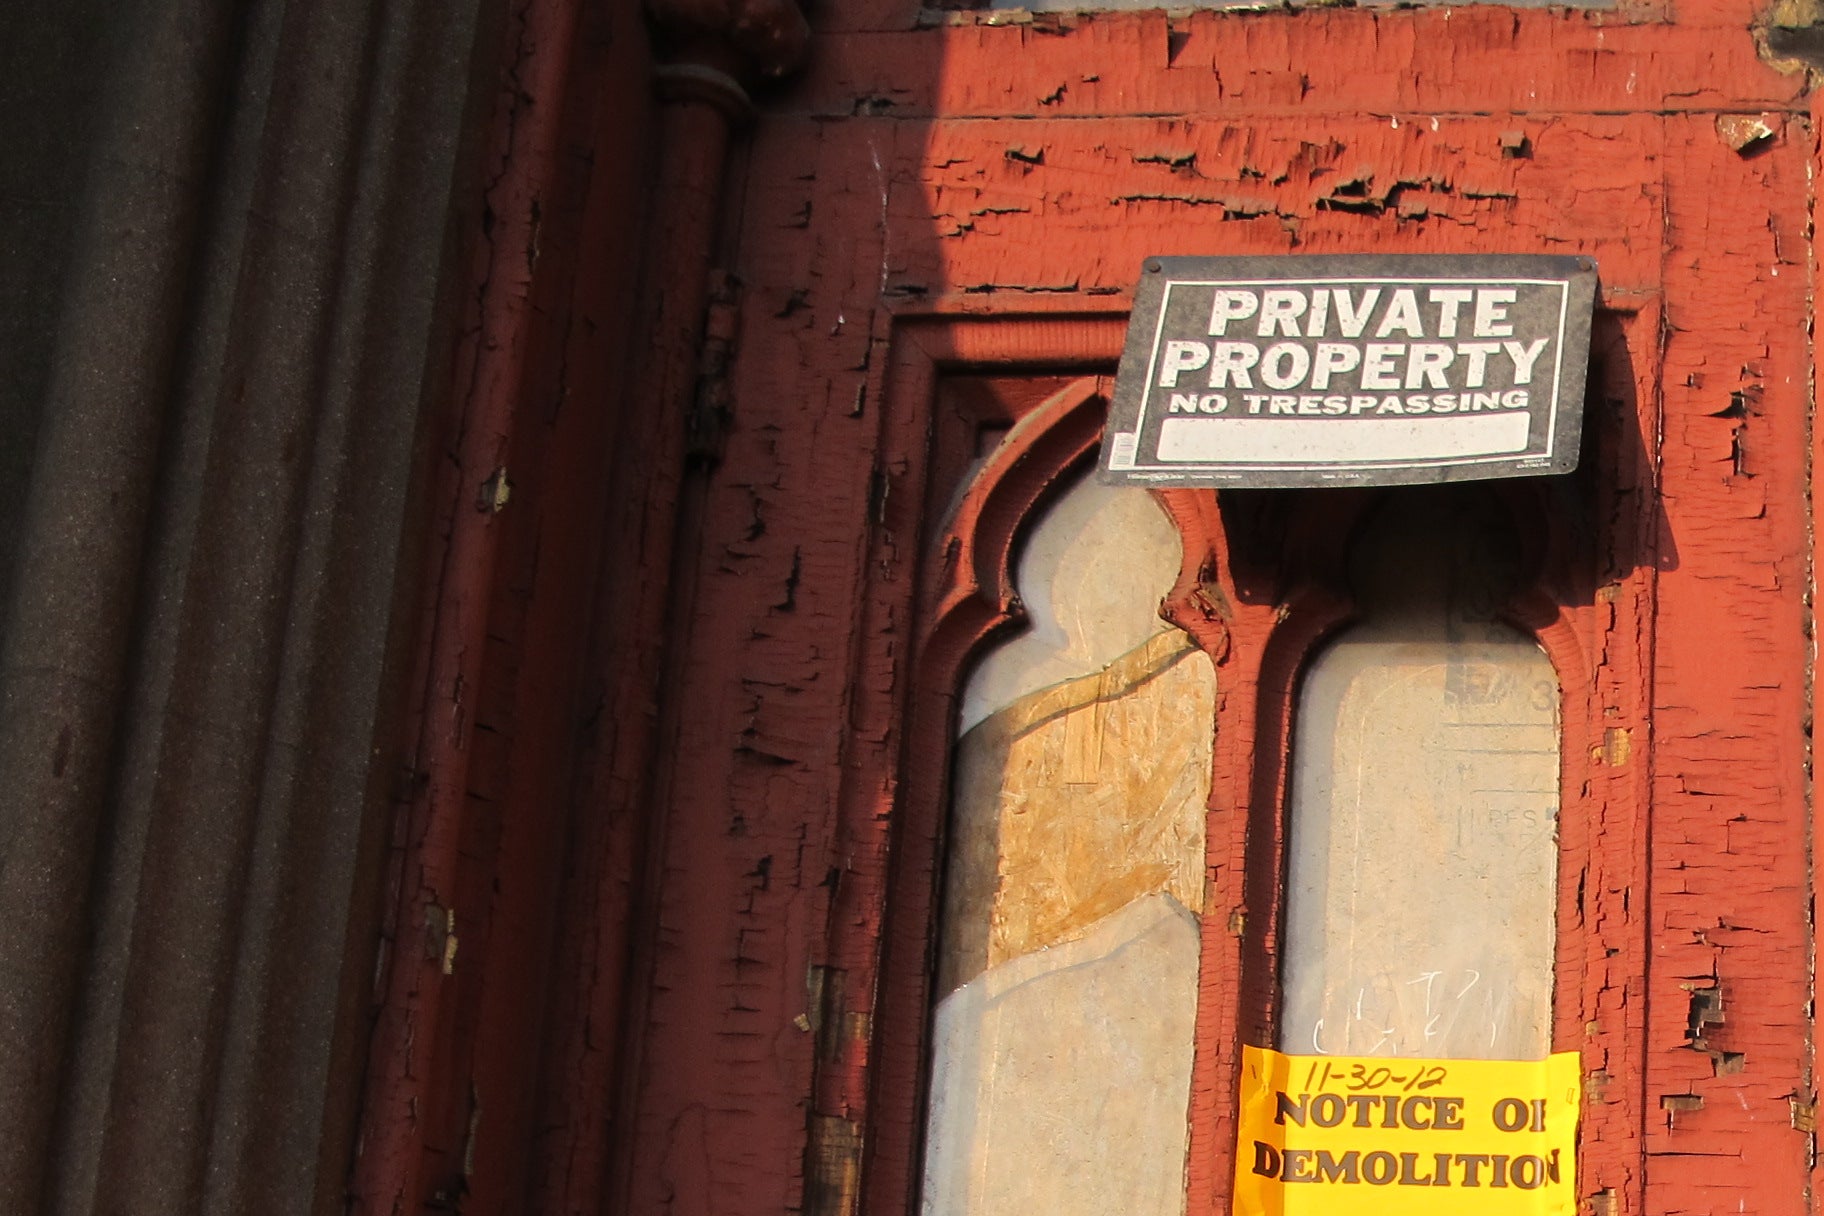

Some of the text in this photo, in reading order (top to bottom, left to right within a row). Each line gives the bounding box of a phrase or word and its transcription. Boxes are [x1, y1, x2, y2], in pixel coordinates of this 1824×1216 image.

[1207, 288, 1517, 338] PRIVATE
[1159, 338, 1550, 390] PROPERTY
[1168, 390, 1530, 415] NO TRESPASSING
[1304, 1061, 1448, 1091] 11-30-12
[1273, 1090, 1465, 1131] NOTICE
[1252, 1140, 1561, 1190] DEMOLITION
